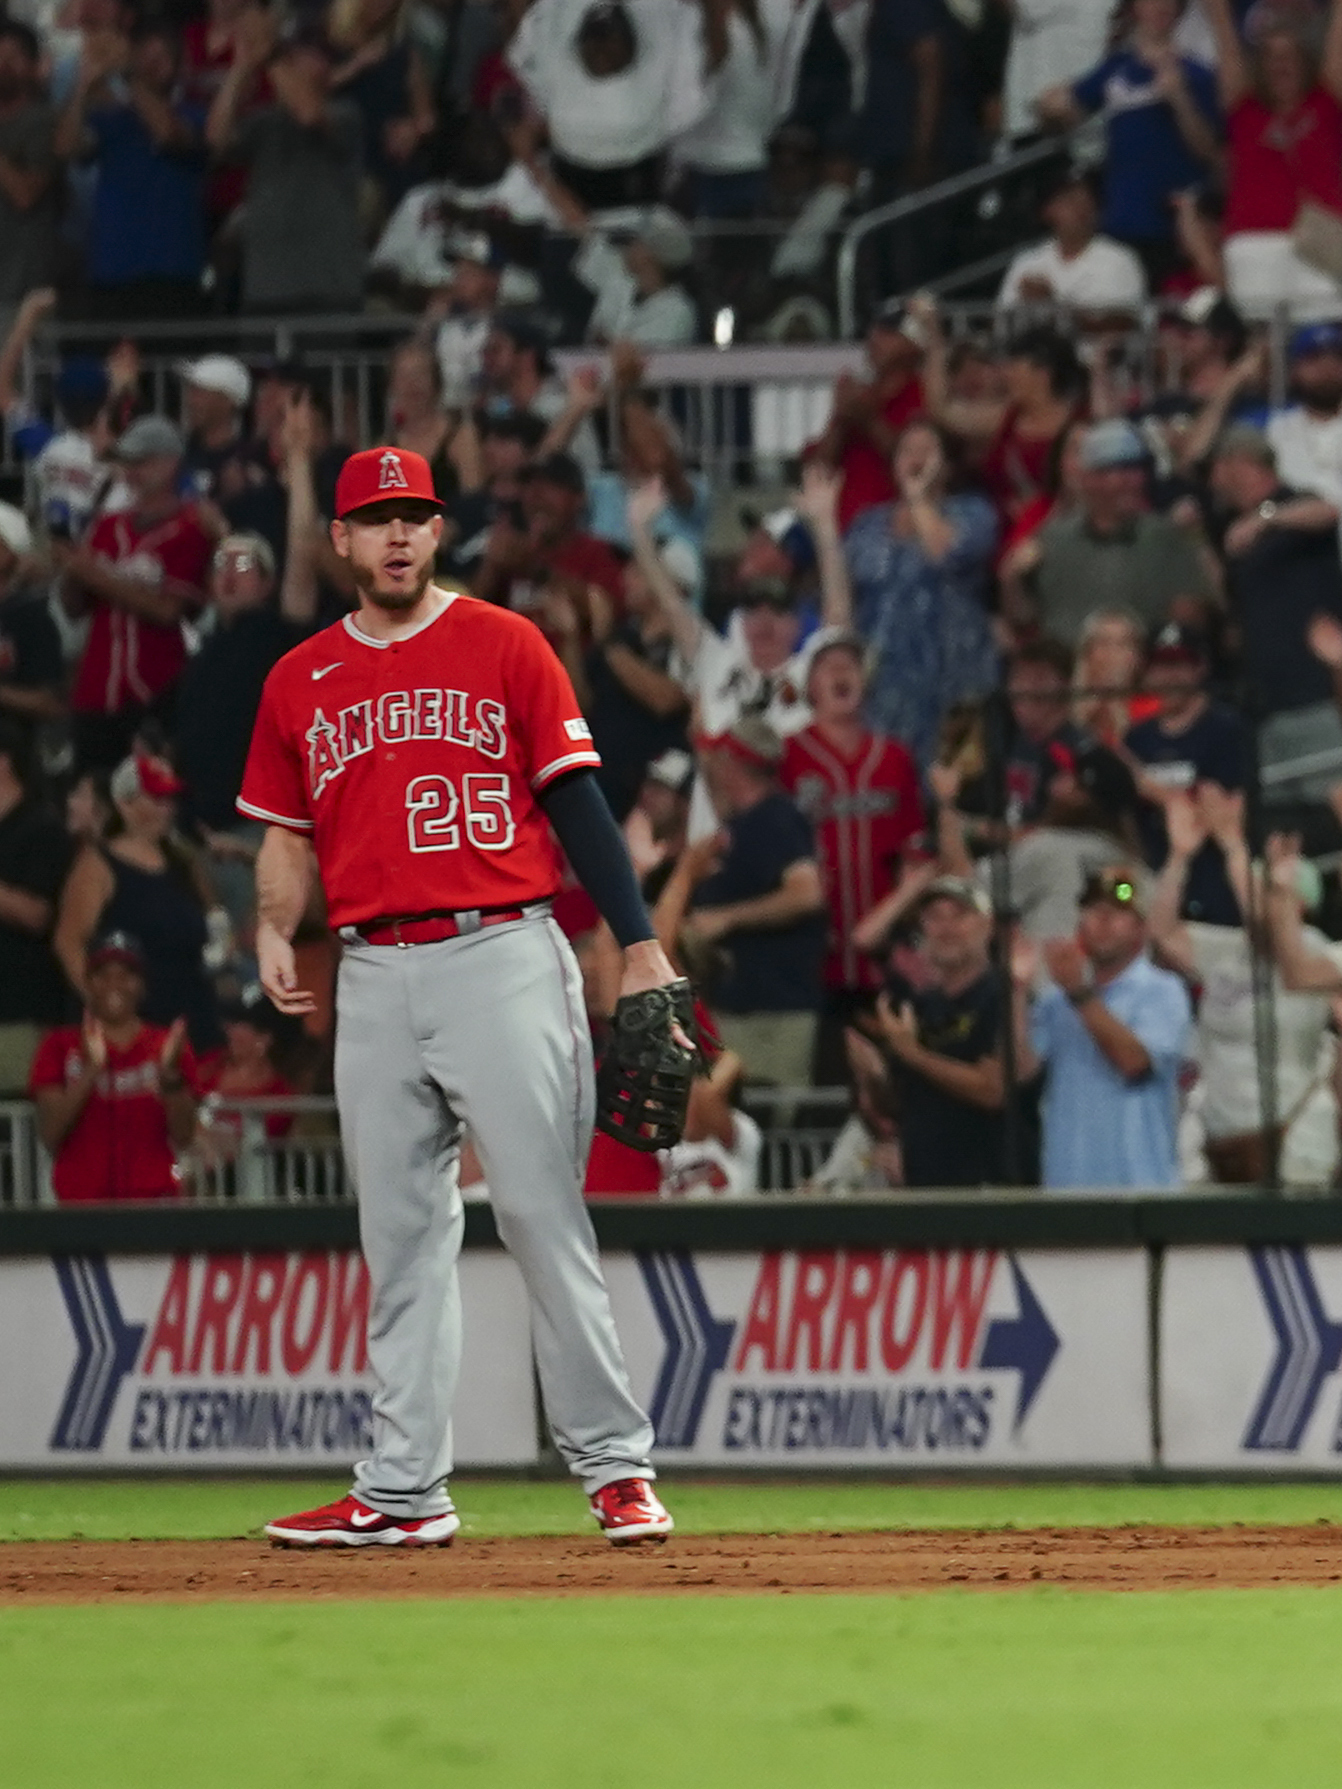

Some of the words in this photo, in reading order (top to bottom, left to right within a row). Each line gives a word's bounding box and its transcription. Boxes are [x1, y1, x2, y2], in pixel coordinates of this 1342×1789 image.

[305, 687, 506, 801] ANGELS
[404, 772, 516, 853] 25
[142, 1250, 371, 1377] ARROW
[734, 1248, 998, 1373] ARROW
[724, 1388, 994, 1450] EXTERMINATORS
